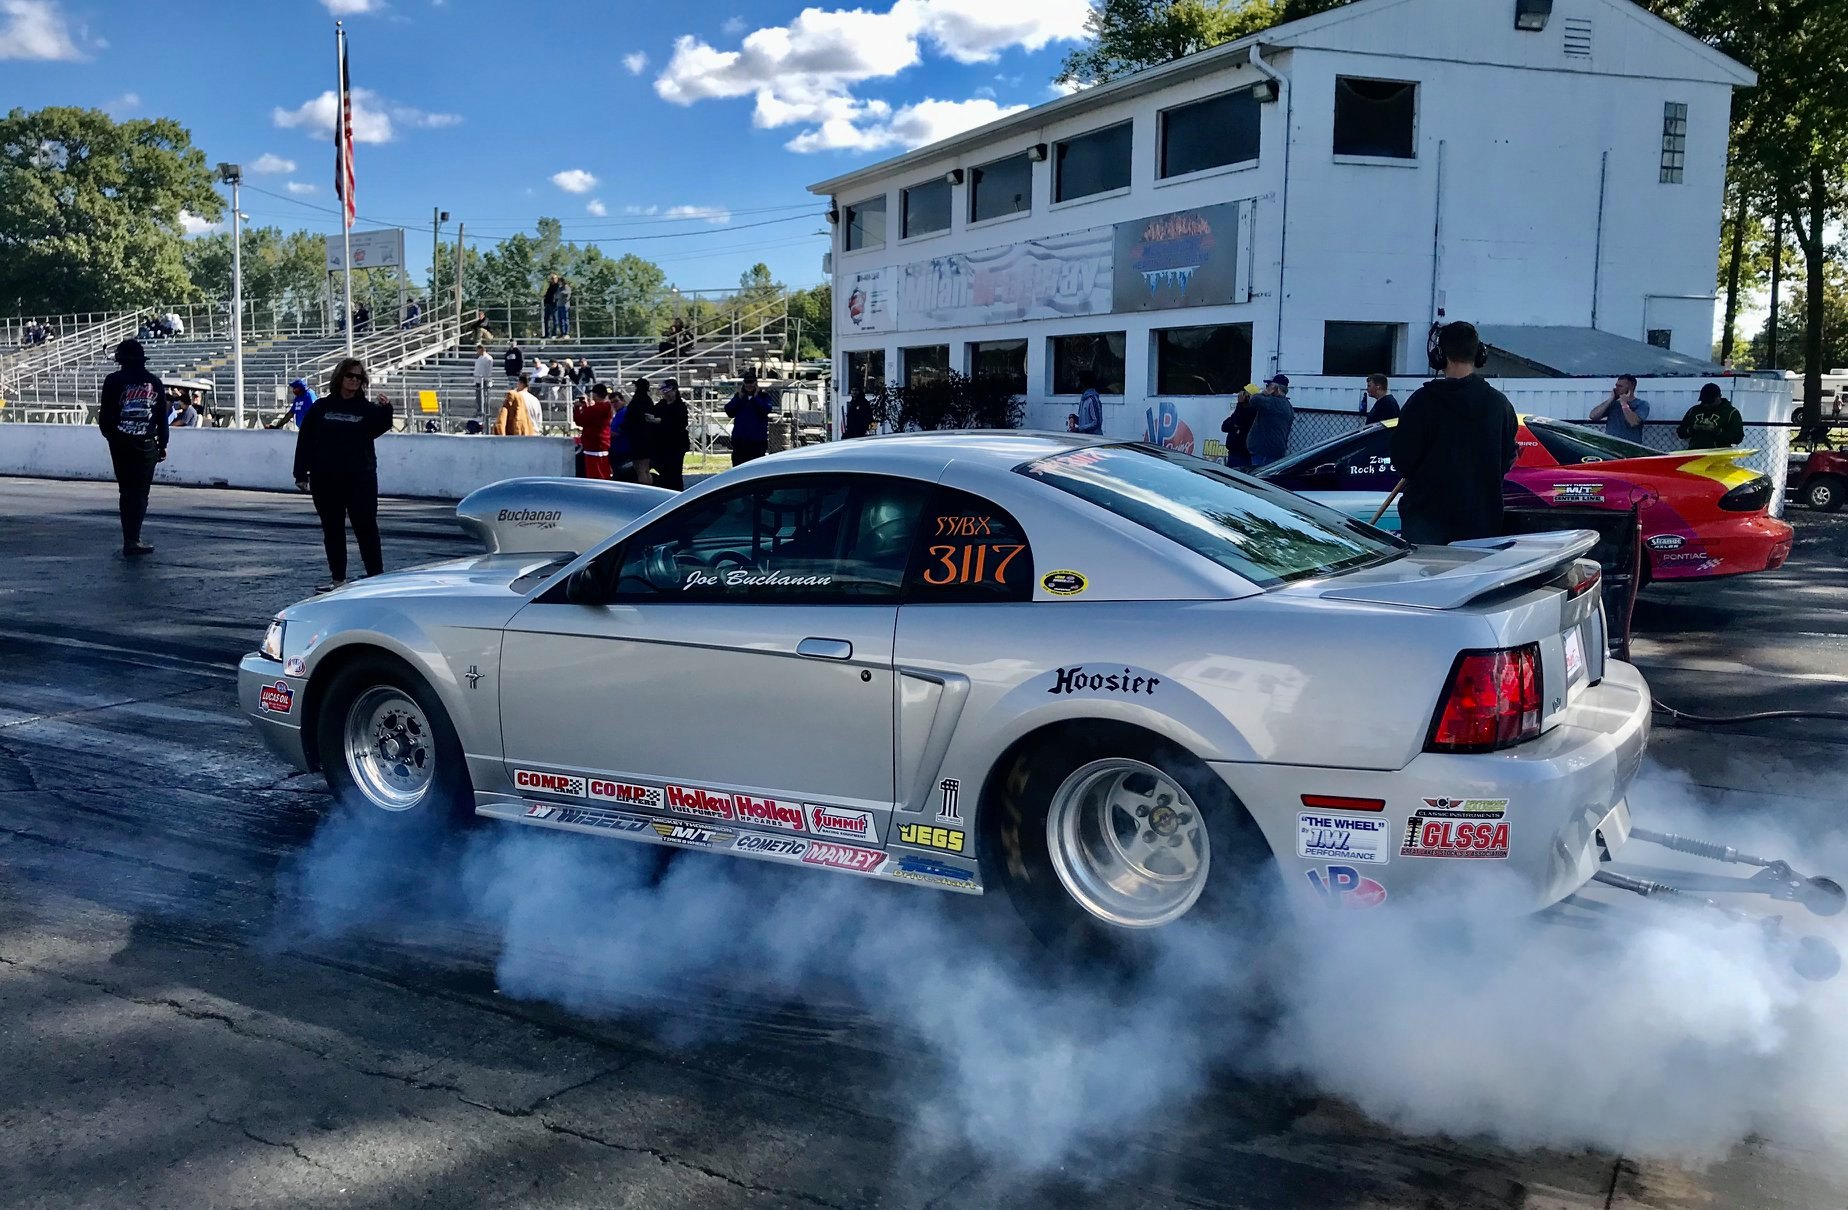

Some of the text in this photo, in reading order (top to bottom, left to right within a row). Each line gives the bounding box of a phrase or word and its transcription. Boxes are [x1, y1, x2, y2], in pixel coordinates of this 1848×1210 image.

[904, 262, 967, 311] Milan
[1350, 465, 1375, 474] Rock
[1379, 464, 1386, 472] &
[1566, 486, 1593, 494] M/T
[497, 508, 562, 521] Buchanan
[935, 516, 991, 536] SS/BX
[923, 544, 1025, 584] 3117
[1663, 552, 1707, 560] PONTIAC
[682, 569, 831, 591] Joe Buchanan
[1047, 666, 1160, 695] Hoosier
[262, 691, 289, 705] LUCAS OIL
[517, 772, 569, 789] COMP
[553, 787, 580, 795] CAMS
[591, 781, 646, 800] COMP
[616, 795, 657, 806] LIFTERS
[668, 786, 733, 819] Holley
[672, 806, 723, 818] FUEL PUMPS
[735, 796, 803, 829] Holley
[754, 817, 783, 827] CARBS
[671, 826, 717, 842] M/T
[901, 823, 965, 852] JEGS
[1422, 821, 1510, 850] GLSSA
[737, 836, 806, 855] COMETIC
[1305, 849, 1376, 860] PERFORMANCE
[806, 844, 877, 869] MANLEY
